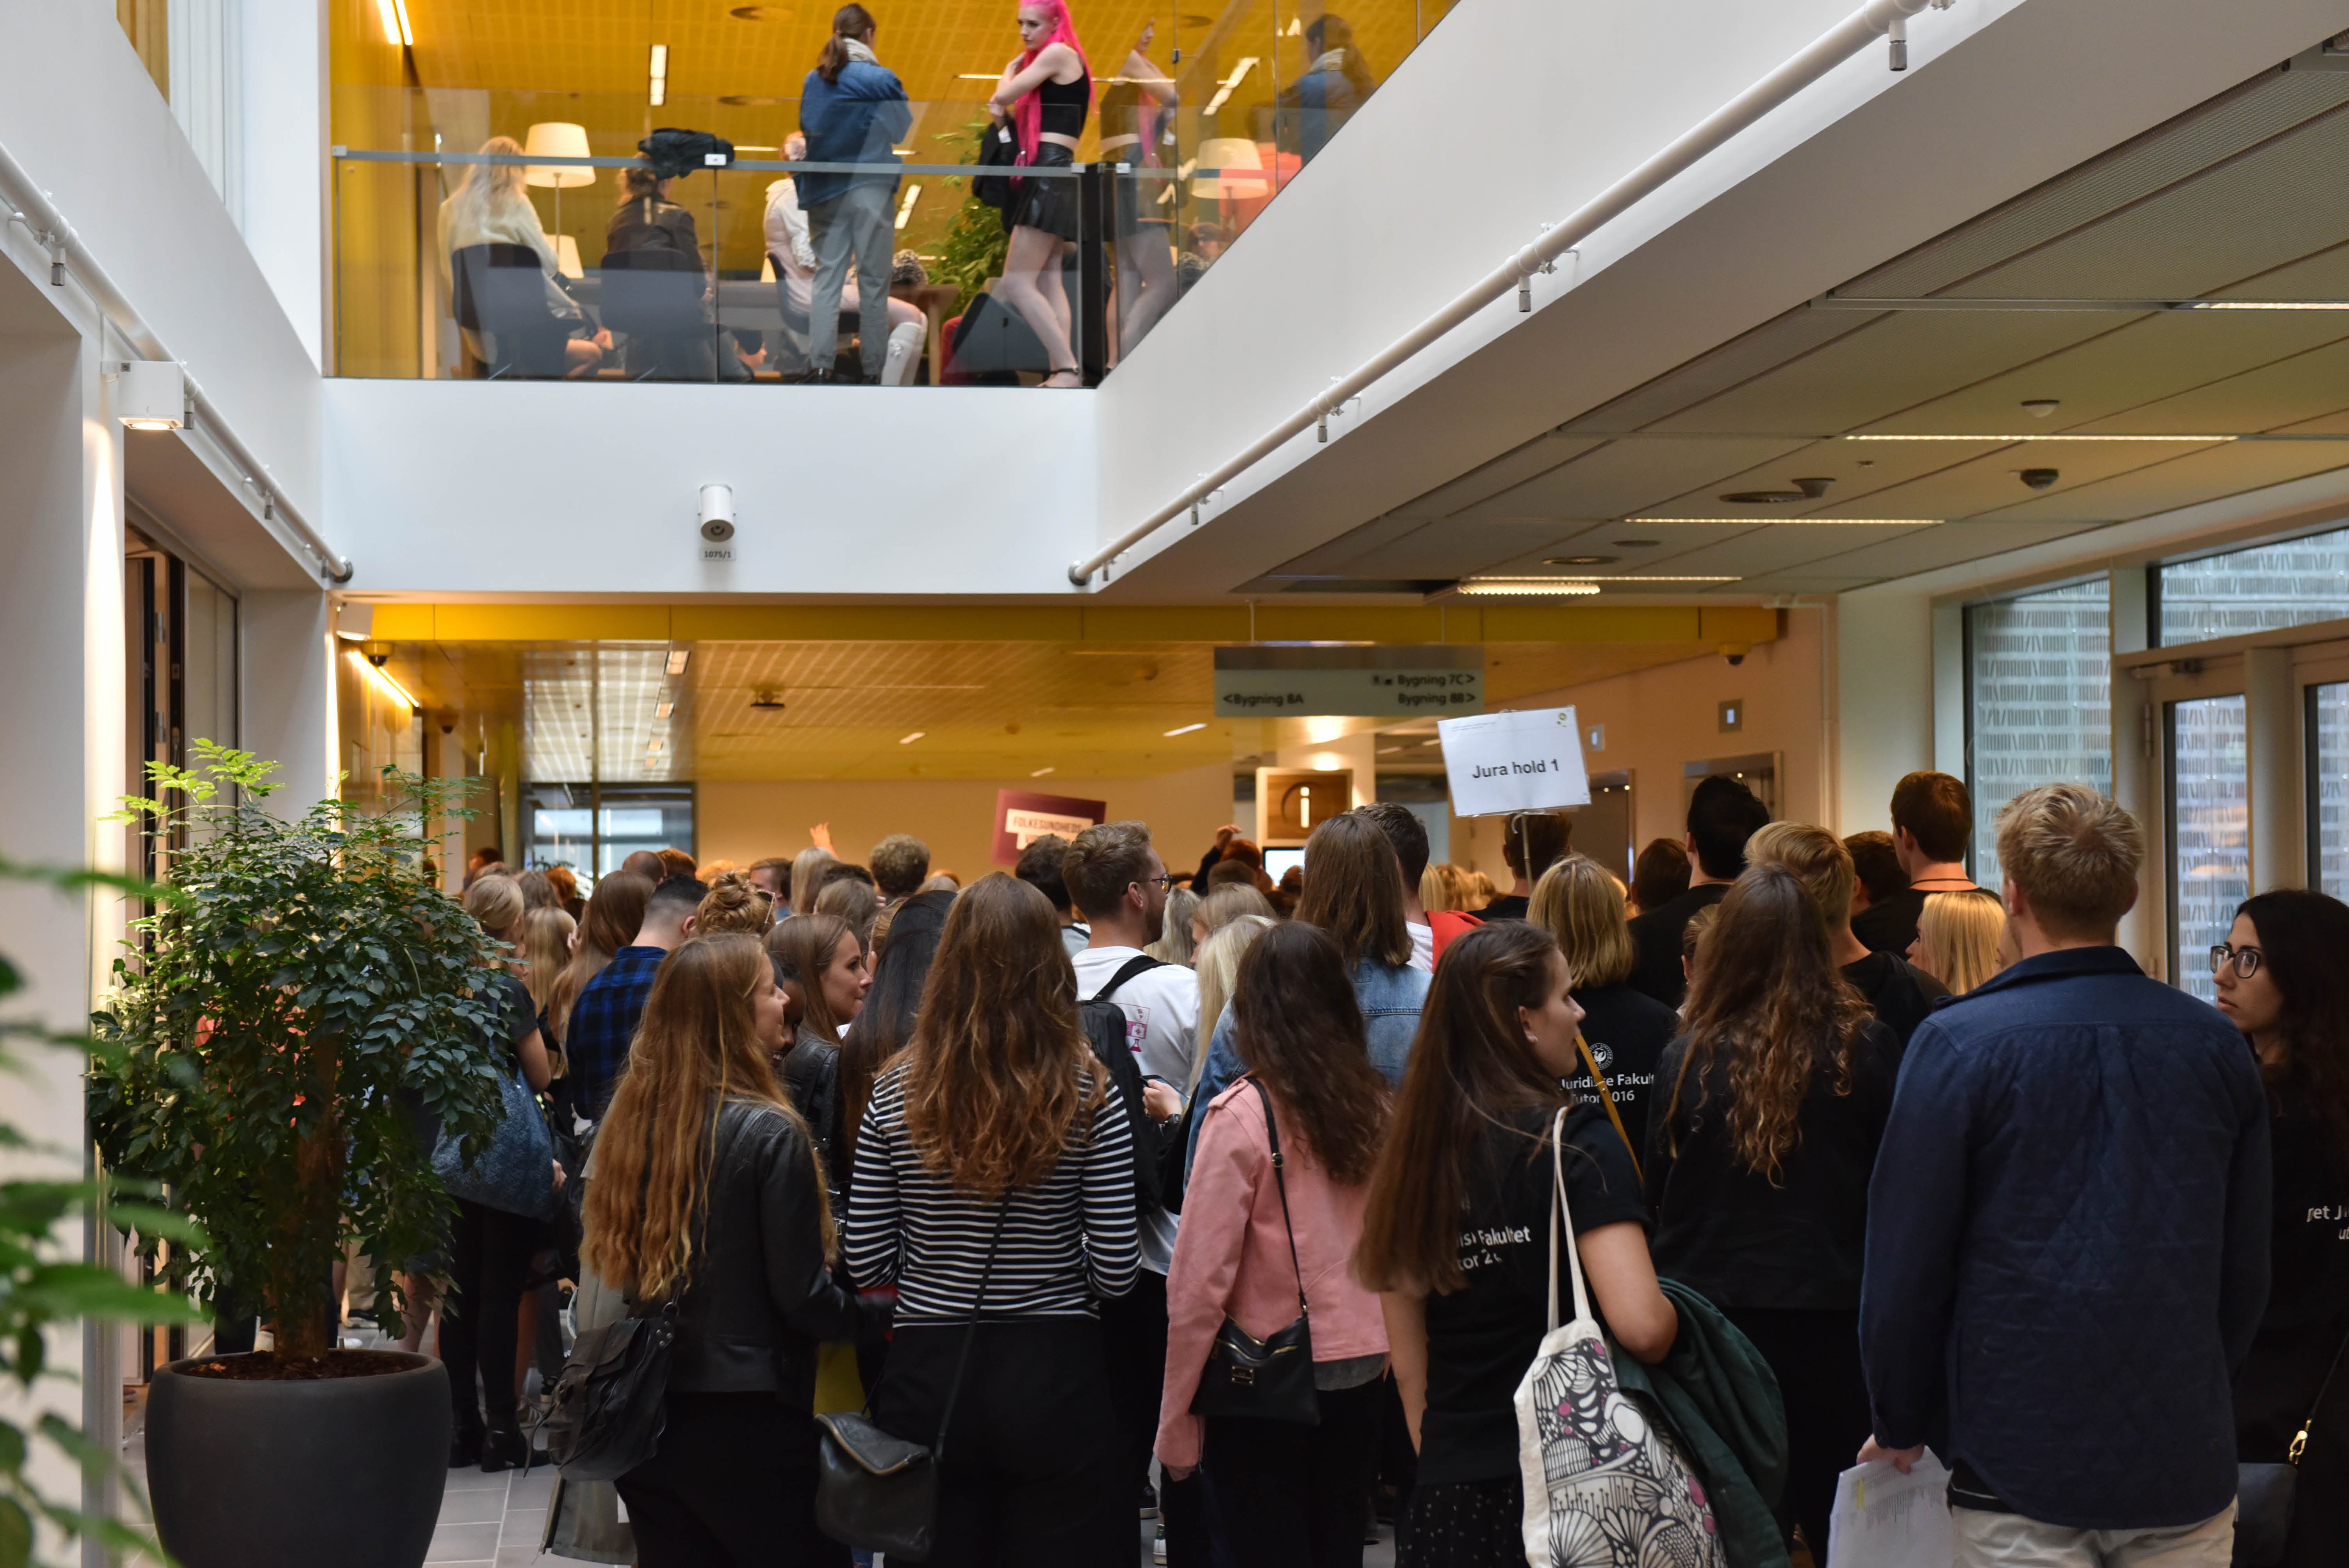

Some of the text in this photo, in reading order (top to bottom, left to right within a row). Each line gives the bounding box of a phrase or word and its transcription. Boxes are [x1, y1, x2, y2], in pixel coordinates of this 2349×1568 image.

[704, 551, 731, 559] 1075/1
[1398, 674, 1464, 687] Bygning 7C
[1234, 693, 1283, 707] Bygning
[1399, 693, 1446, 706] Bygning
[1472, 759, 1559, 779] Jura hold 1
[1611, 1090, 1635, 1102] 016
